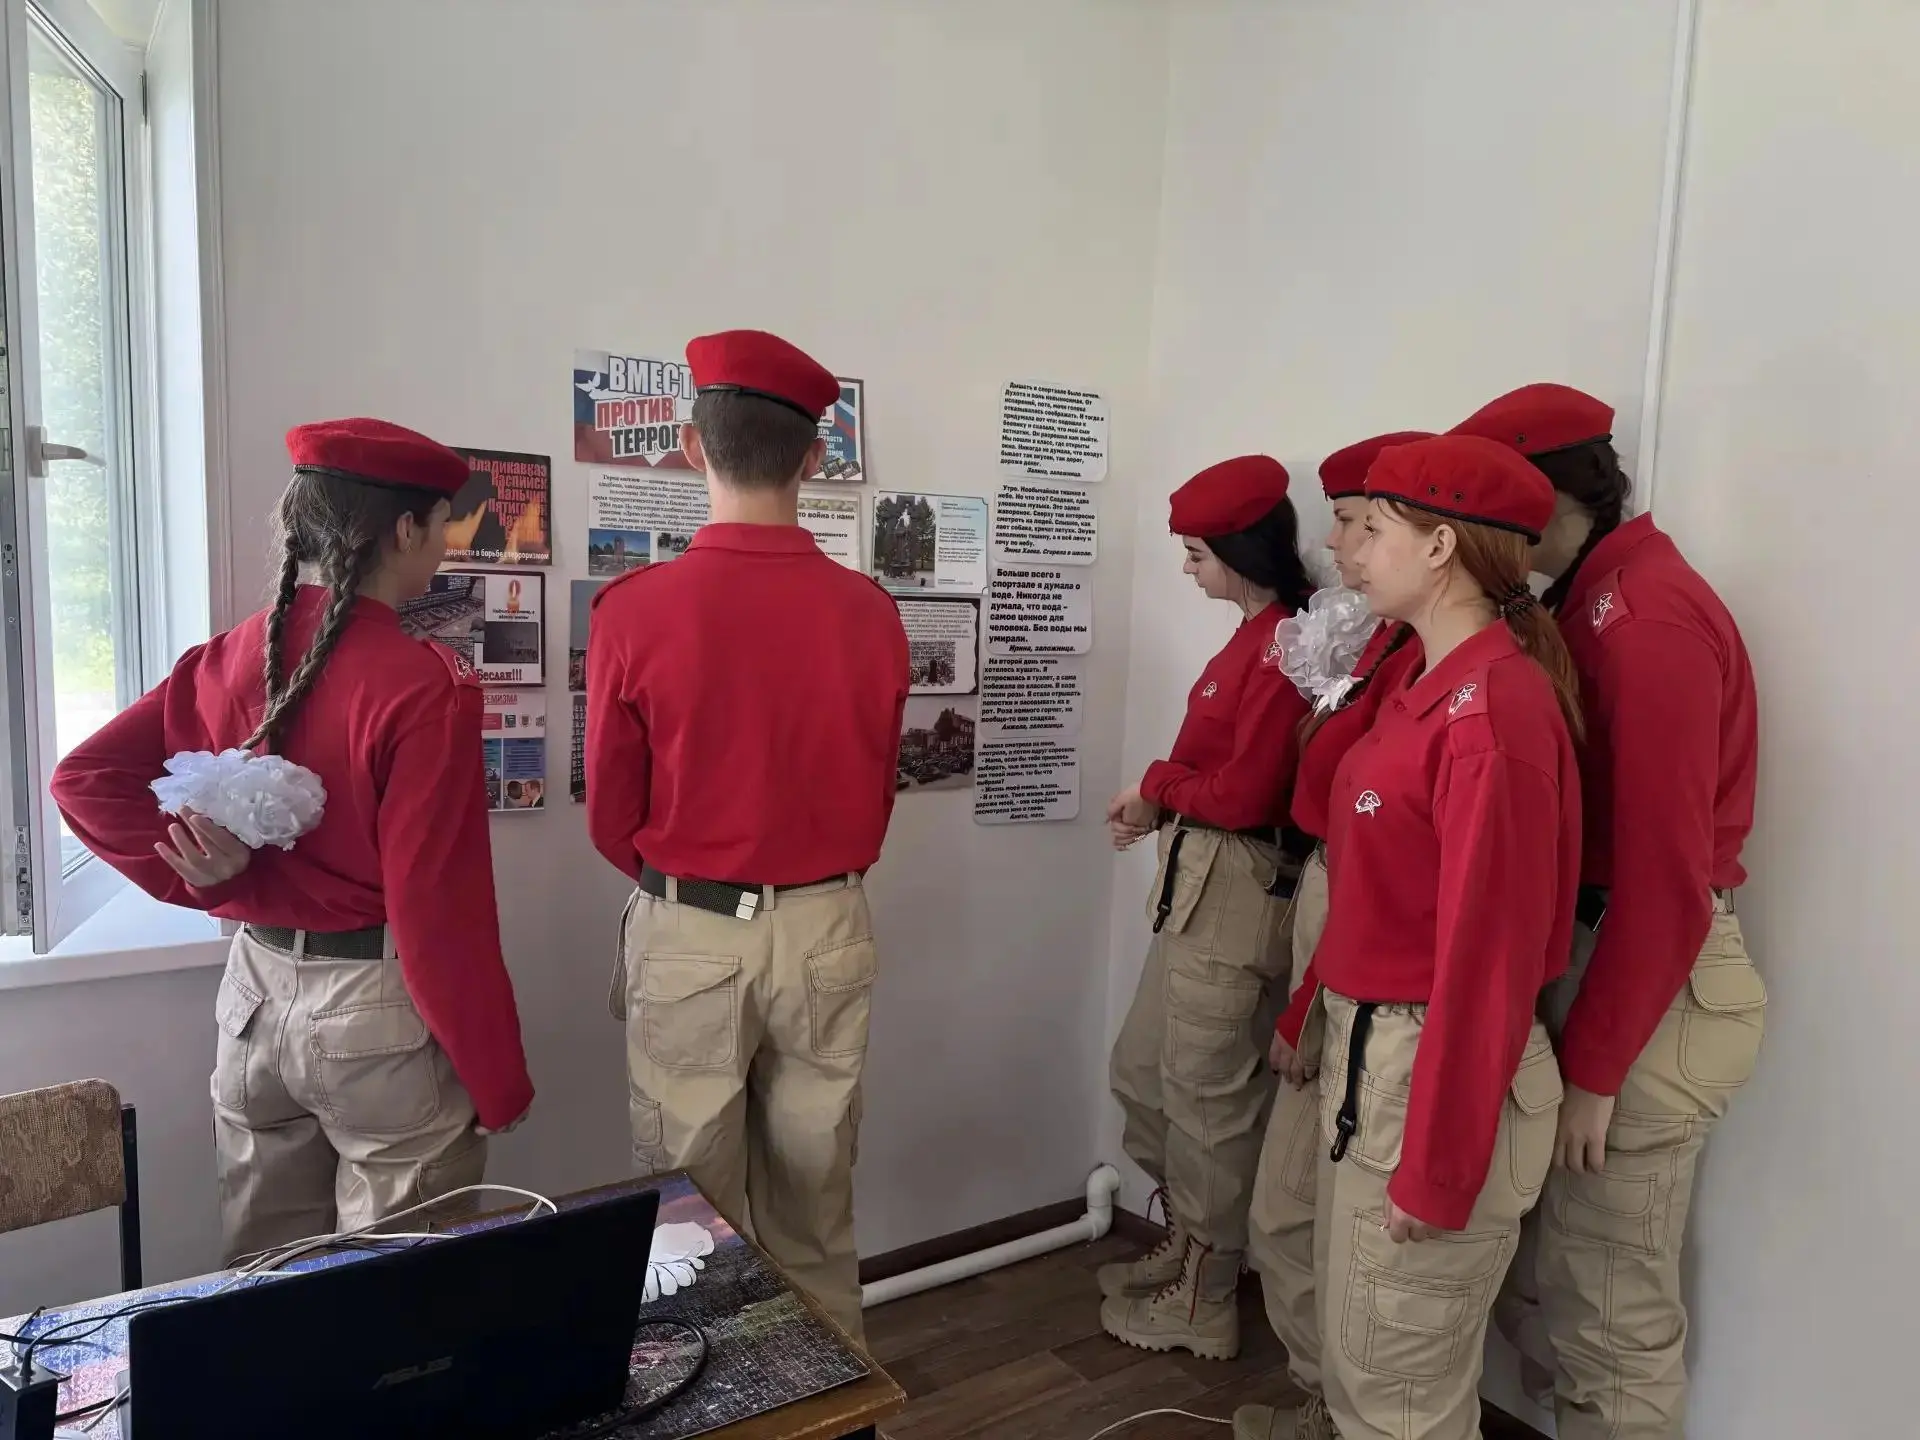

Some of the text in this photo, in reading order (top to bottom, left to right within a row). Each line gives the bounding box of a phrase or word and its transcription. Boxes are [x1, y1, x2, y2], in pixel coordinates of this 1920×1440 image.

[608, 356, 697, 399] ВМЕСТ
[596, 397, 674, 429] ПРОТИВ
[469, 456, 547, 476] Владикавказ
[481, 549, 503, 559] борьбе
[997, 569, 1029, 577] Больше
[992, 580, 1035, 589] спортзале
[1044, 582, 1073, 591] думала
[992, 591, 1014, 599] воде.
[1016, 591, 1050, 600] Никогда
[991, 603, 1024, 611] думала,
[1033, 624, 1048, 632] Без
[989, 635, 1028, 643] умирали.
